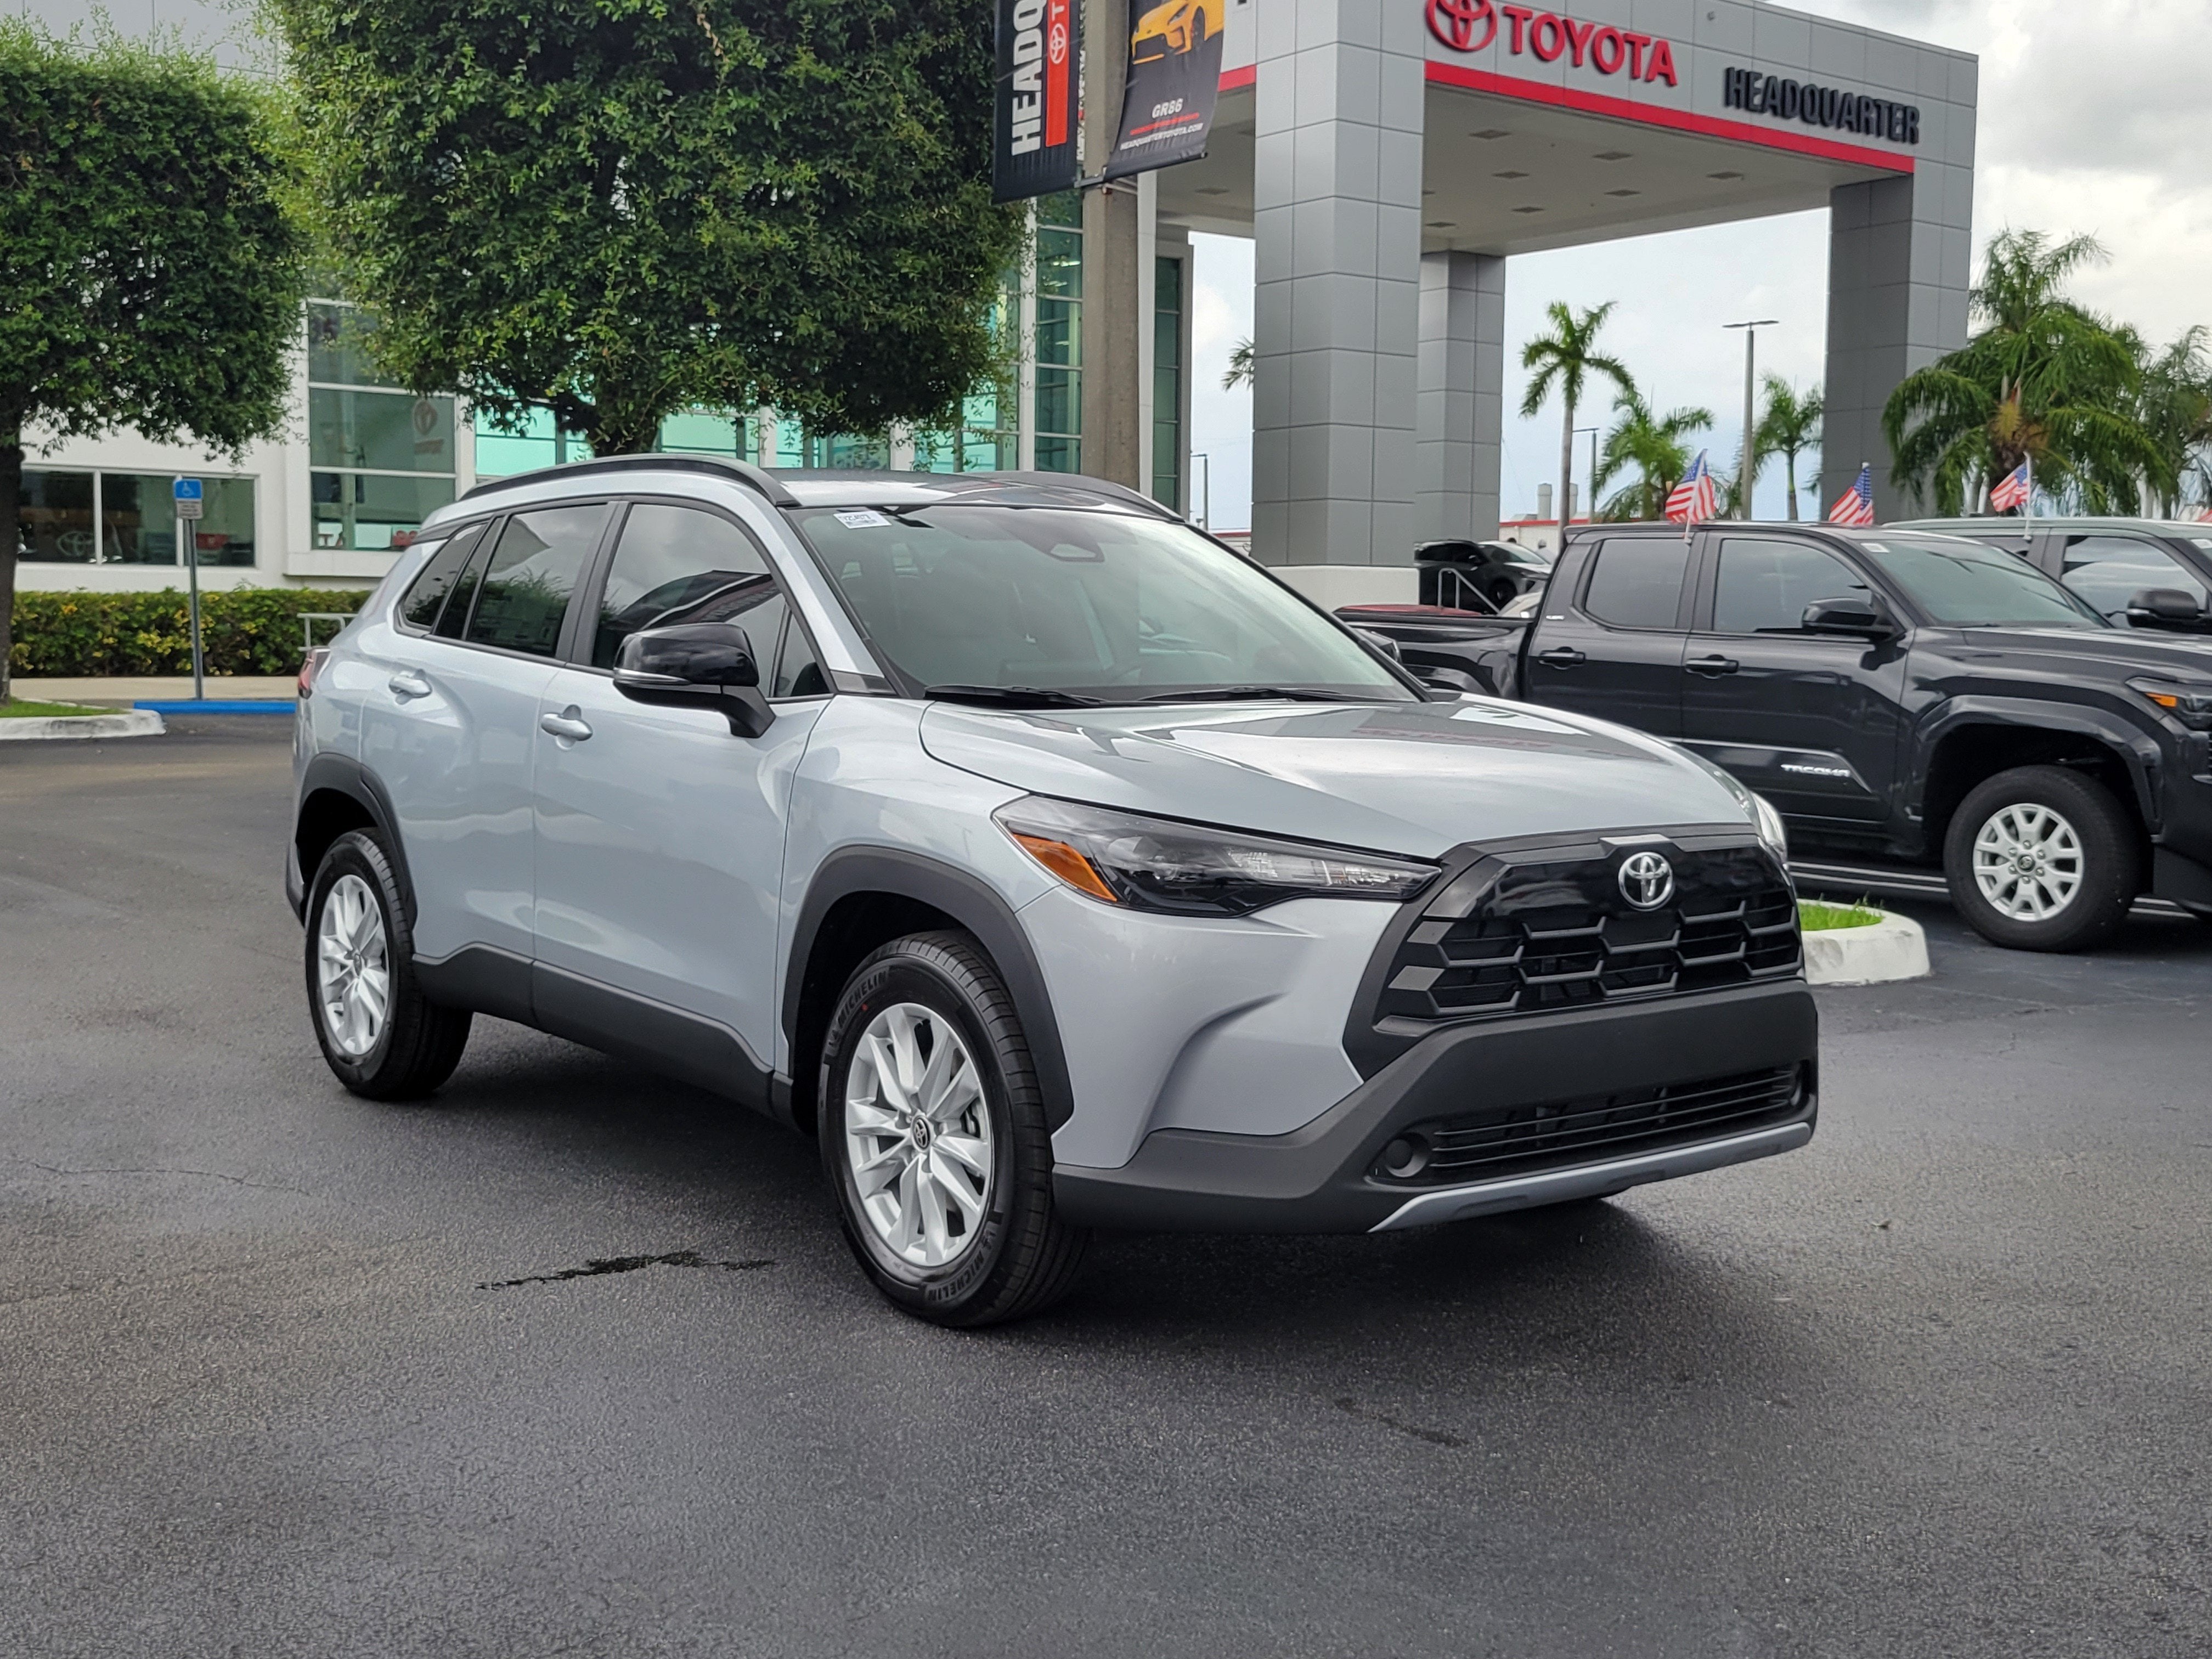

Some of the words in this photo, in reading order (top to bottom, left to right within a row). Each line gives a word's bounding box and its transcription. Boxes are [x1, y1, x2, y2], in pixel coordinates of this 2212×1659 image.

[1503, 5, 1677, 87] TOYOTA
[1152, 98, 1184, 119] GR86
[1724, 67, 1920, 145] HEADQUARTER
[1780, 764, 1850, 777] TACOMA
[837, 970, 887, 1030] MICHELIN
[928, 1249, 985, 1301] MICHELIN
